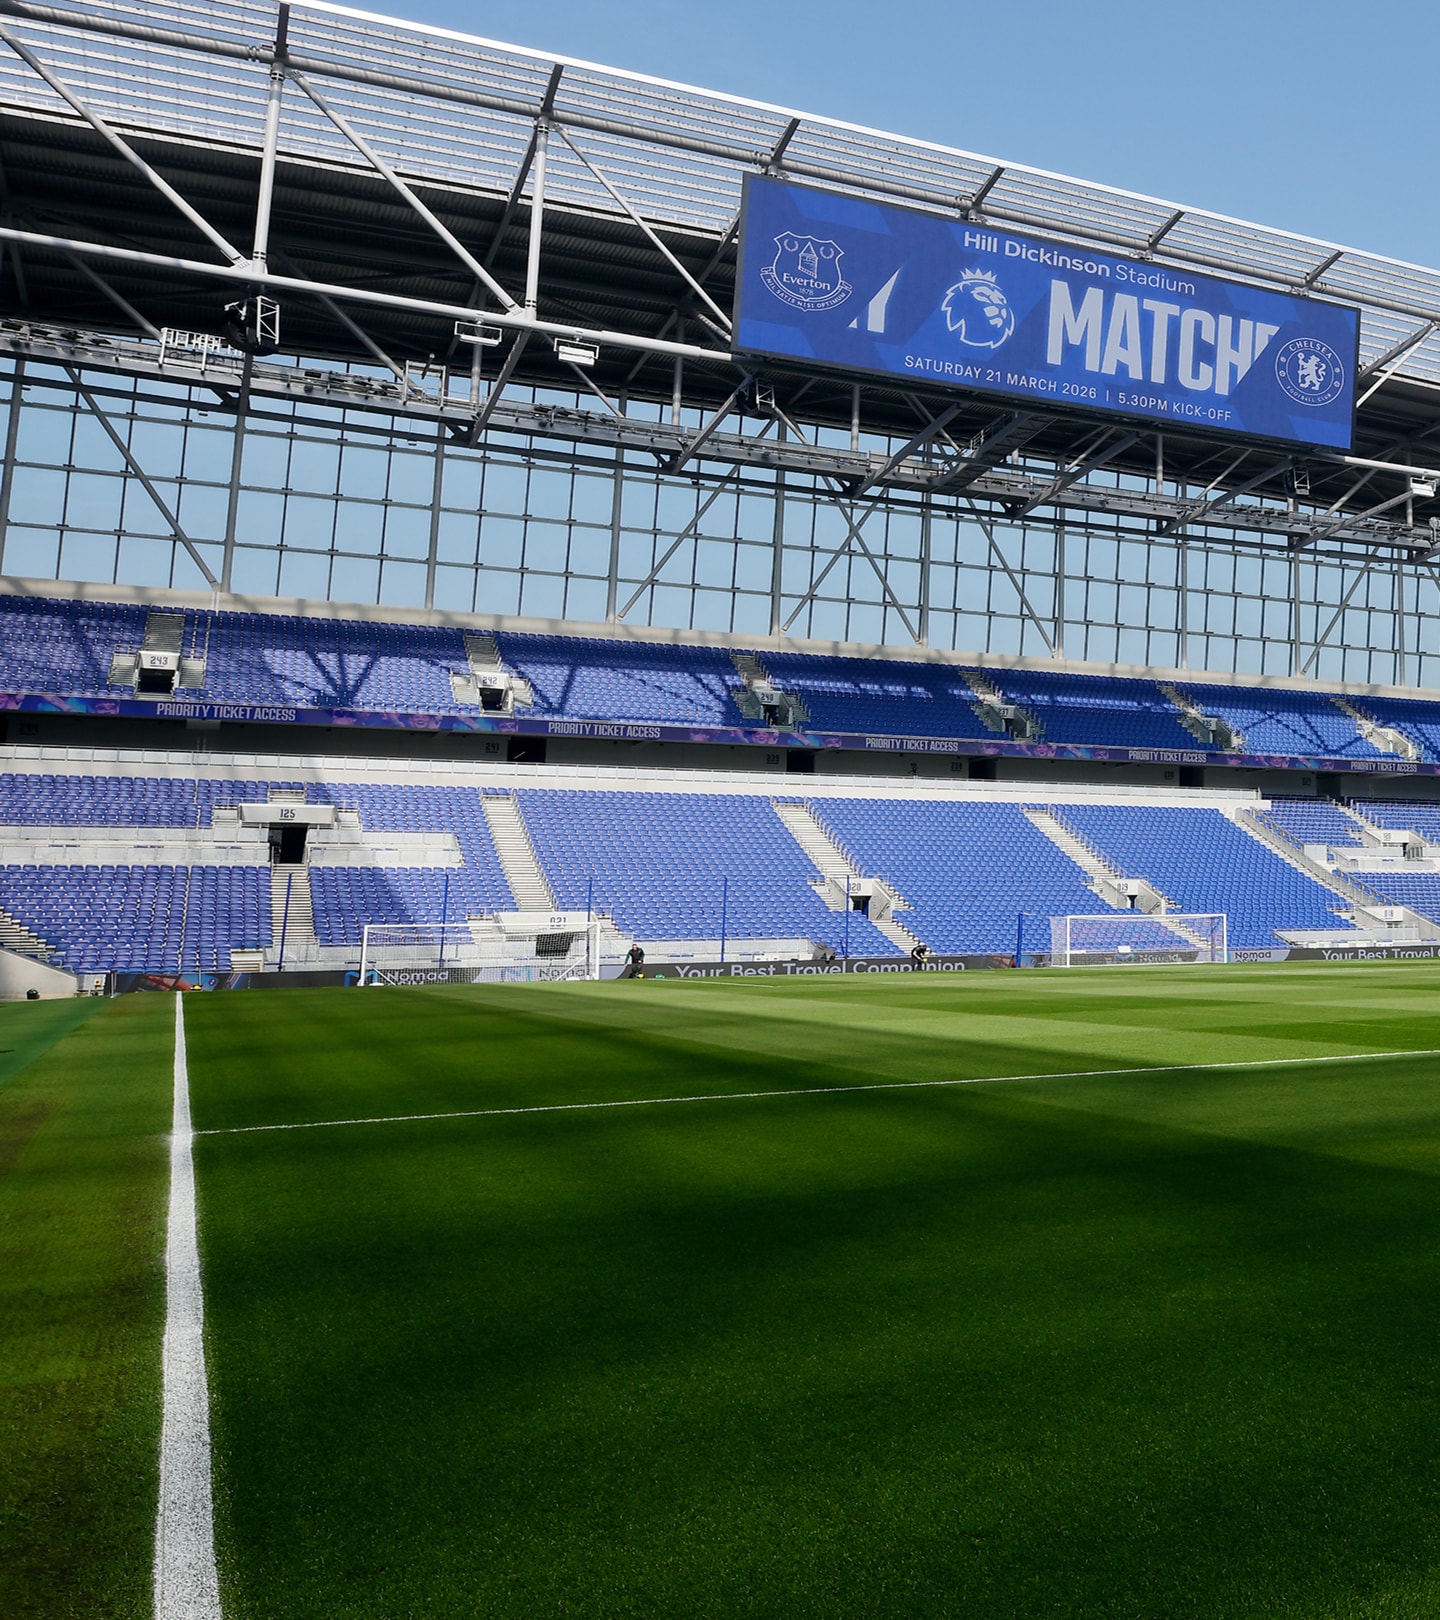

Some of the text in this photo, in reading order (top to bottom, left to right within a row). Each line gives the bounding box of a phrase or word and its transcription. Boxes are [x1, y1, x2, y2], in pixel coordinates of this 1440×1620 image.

[963, 231, 1196, 295] Hill Dickinson Stadium
[782, 272, 831, 291] Everton
[766, 278, 776, 291] NIL
[776, 289, 796, 304] SATIS
[816, 293, 846, 309] OPTIMUM
[1288, 340, 1333, 360] CHELSEA
[904, 354, 1232, 422] SATURDAY 21 MARCH 2026 5.30PM KICK-OFF
[1286, 385, 1332, 403] FOOTBALL CLUB
[150, 655, 169, 666] 243
[482, 676, 498, 686] 242
[156, 702, 296, 722] PRIORITY TICKET ACCESS
[547, 721, 661, 738] PRIORITY TICKET ACCESS
[865, 737, 959, 752] PRIORITY TICKET ACCESS
[1128, 750, 1207, 764] PRIORITY TICKET ACCESS
[1350, 761, 1418, 773] PRIORITY TICKET ACCESS
[280, 809, 296, 819] 125
[550, 916, 566, 928] 021
[1235, 951, 1272, 959] Nomad
[1322, 950, 1355, 960] Your
[1358, 949, 1388, 960] Best
[1391, 948, 1434, 958] Travel
[387, 970, 449, 982] Nomad
[674, 965, 725, 977] Your
[730, 964, 775, 976] Best
[782, 961, 847, 975] Travel
